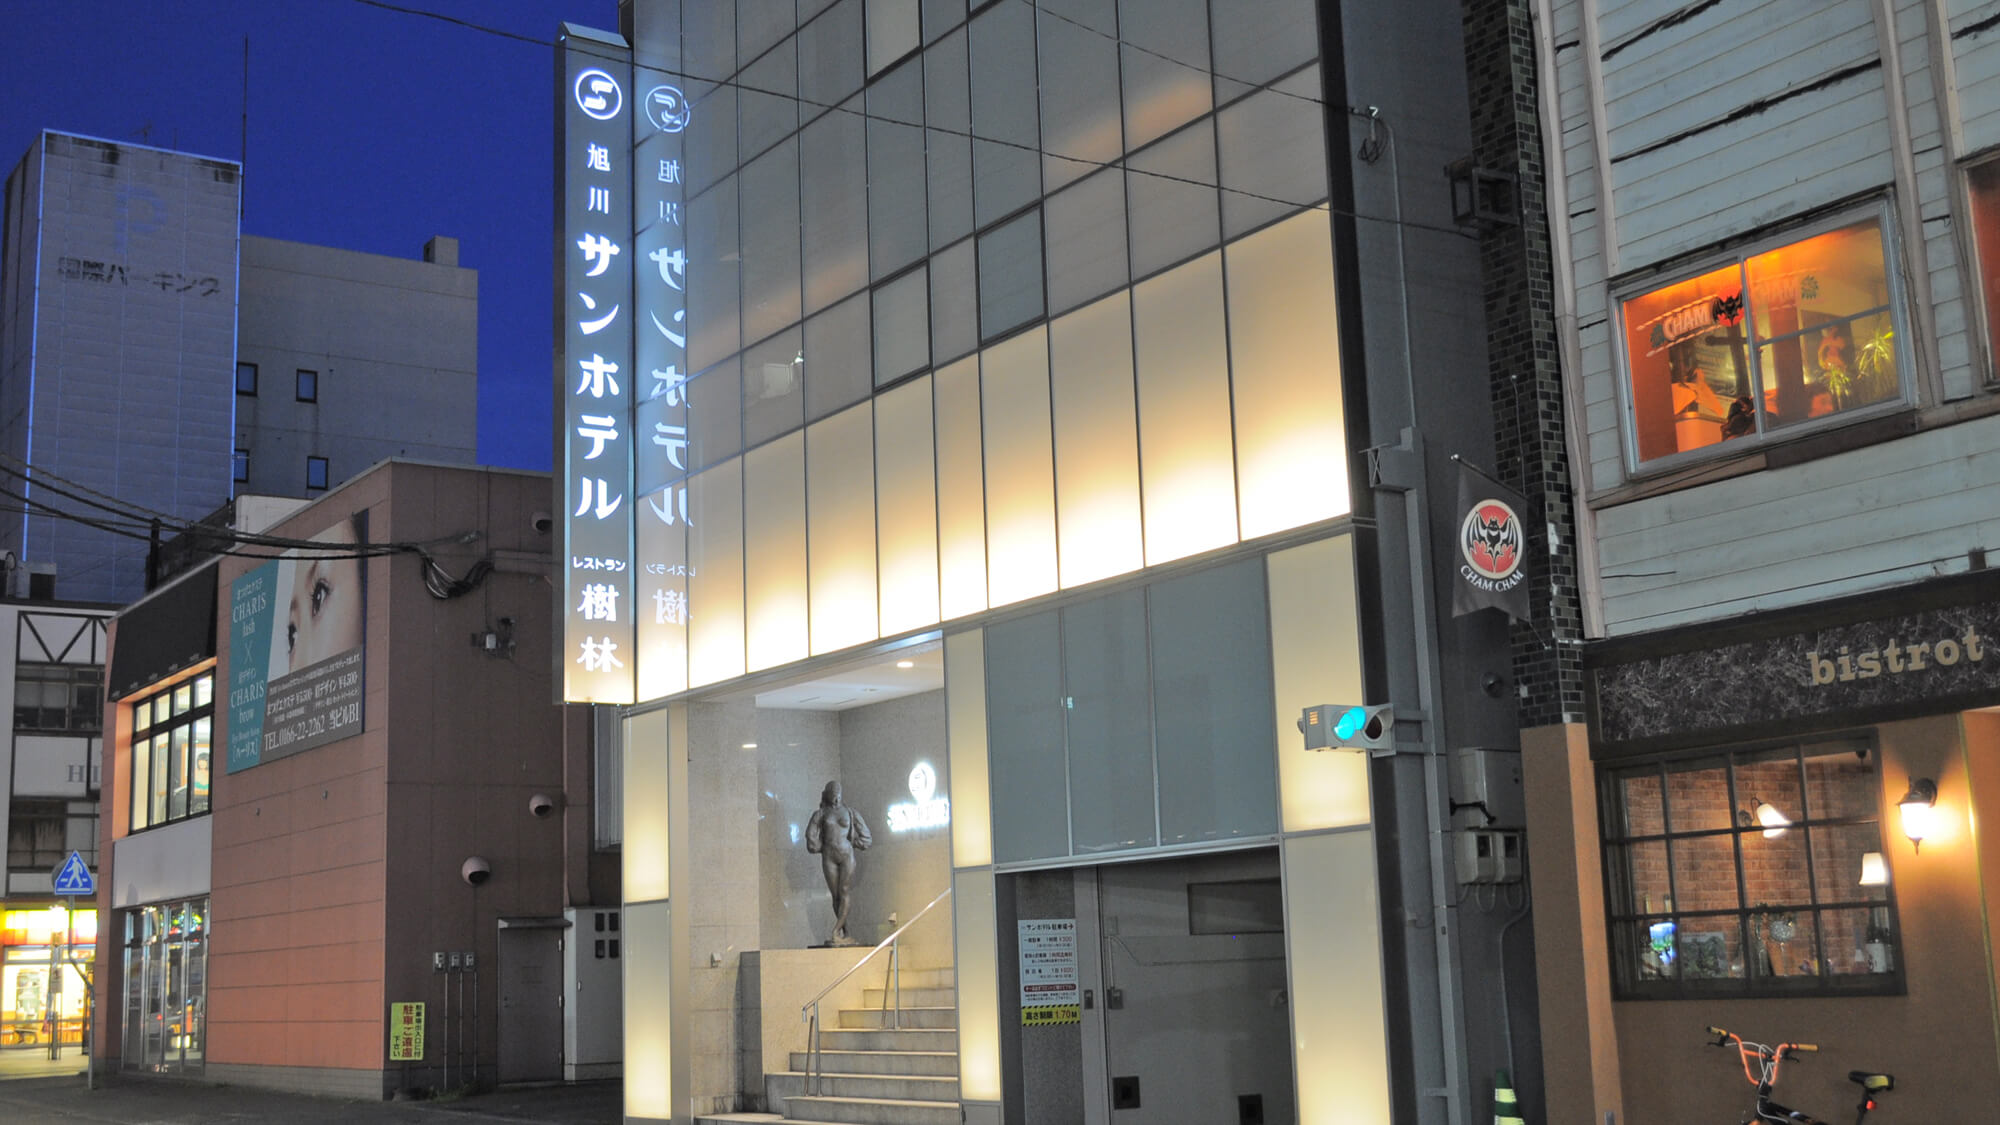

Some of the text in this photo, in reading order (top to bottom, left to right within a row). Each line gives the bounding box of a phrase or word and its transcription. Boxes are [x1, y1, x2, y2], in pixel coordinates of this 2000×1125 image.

[575, 143, 622, 520] 旭川サンホテル
[1662, 302, 1710, 341] CHAM
[573, 556, 625, 572] レストラン
[1460, 565, 1525, 592] CHAM CHAM
[232, 592, 267, 623] CHARIS
[577, 583, 623, 672] 樹林
[1806, 625, 1984, 686] bistrot
[230, 680, 265, 709] CHARIS
